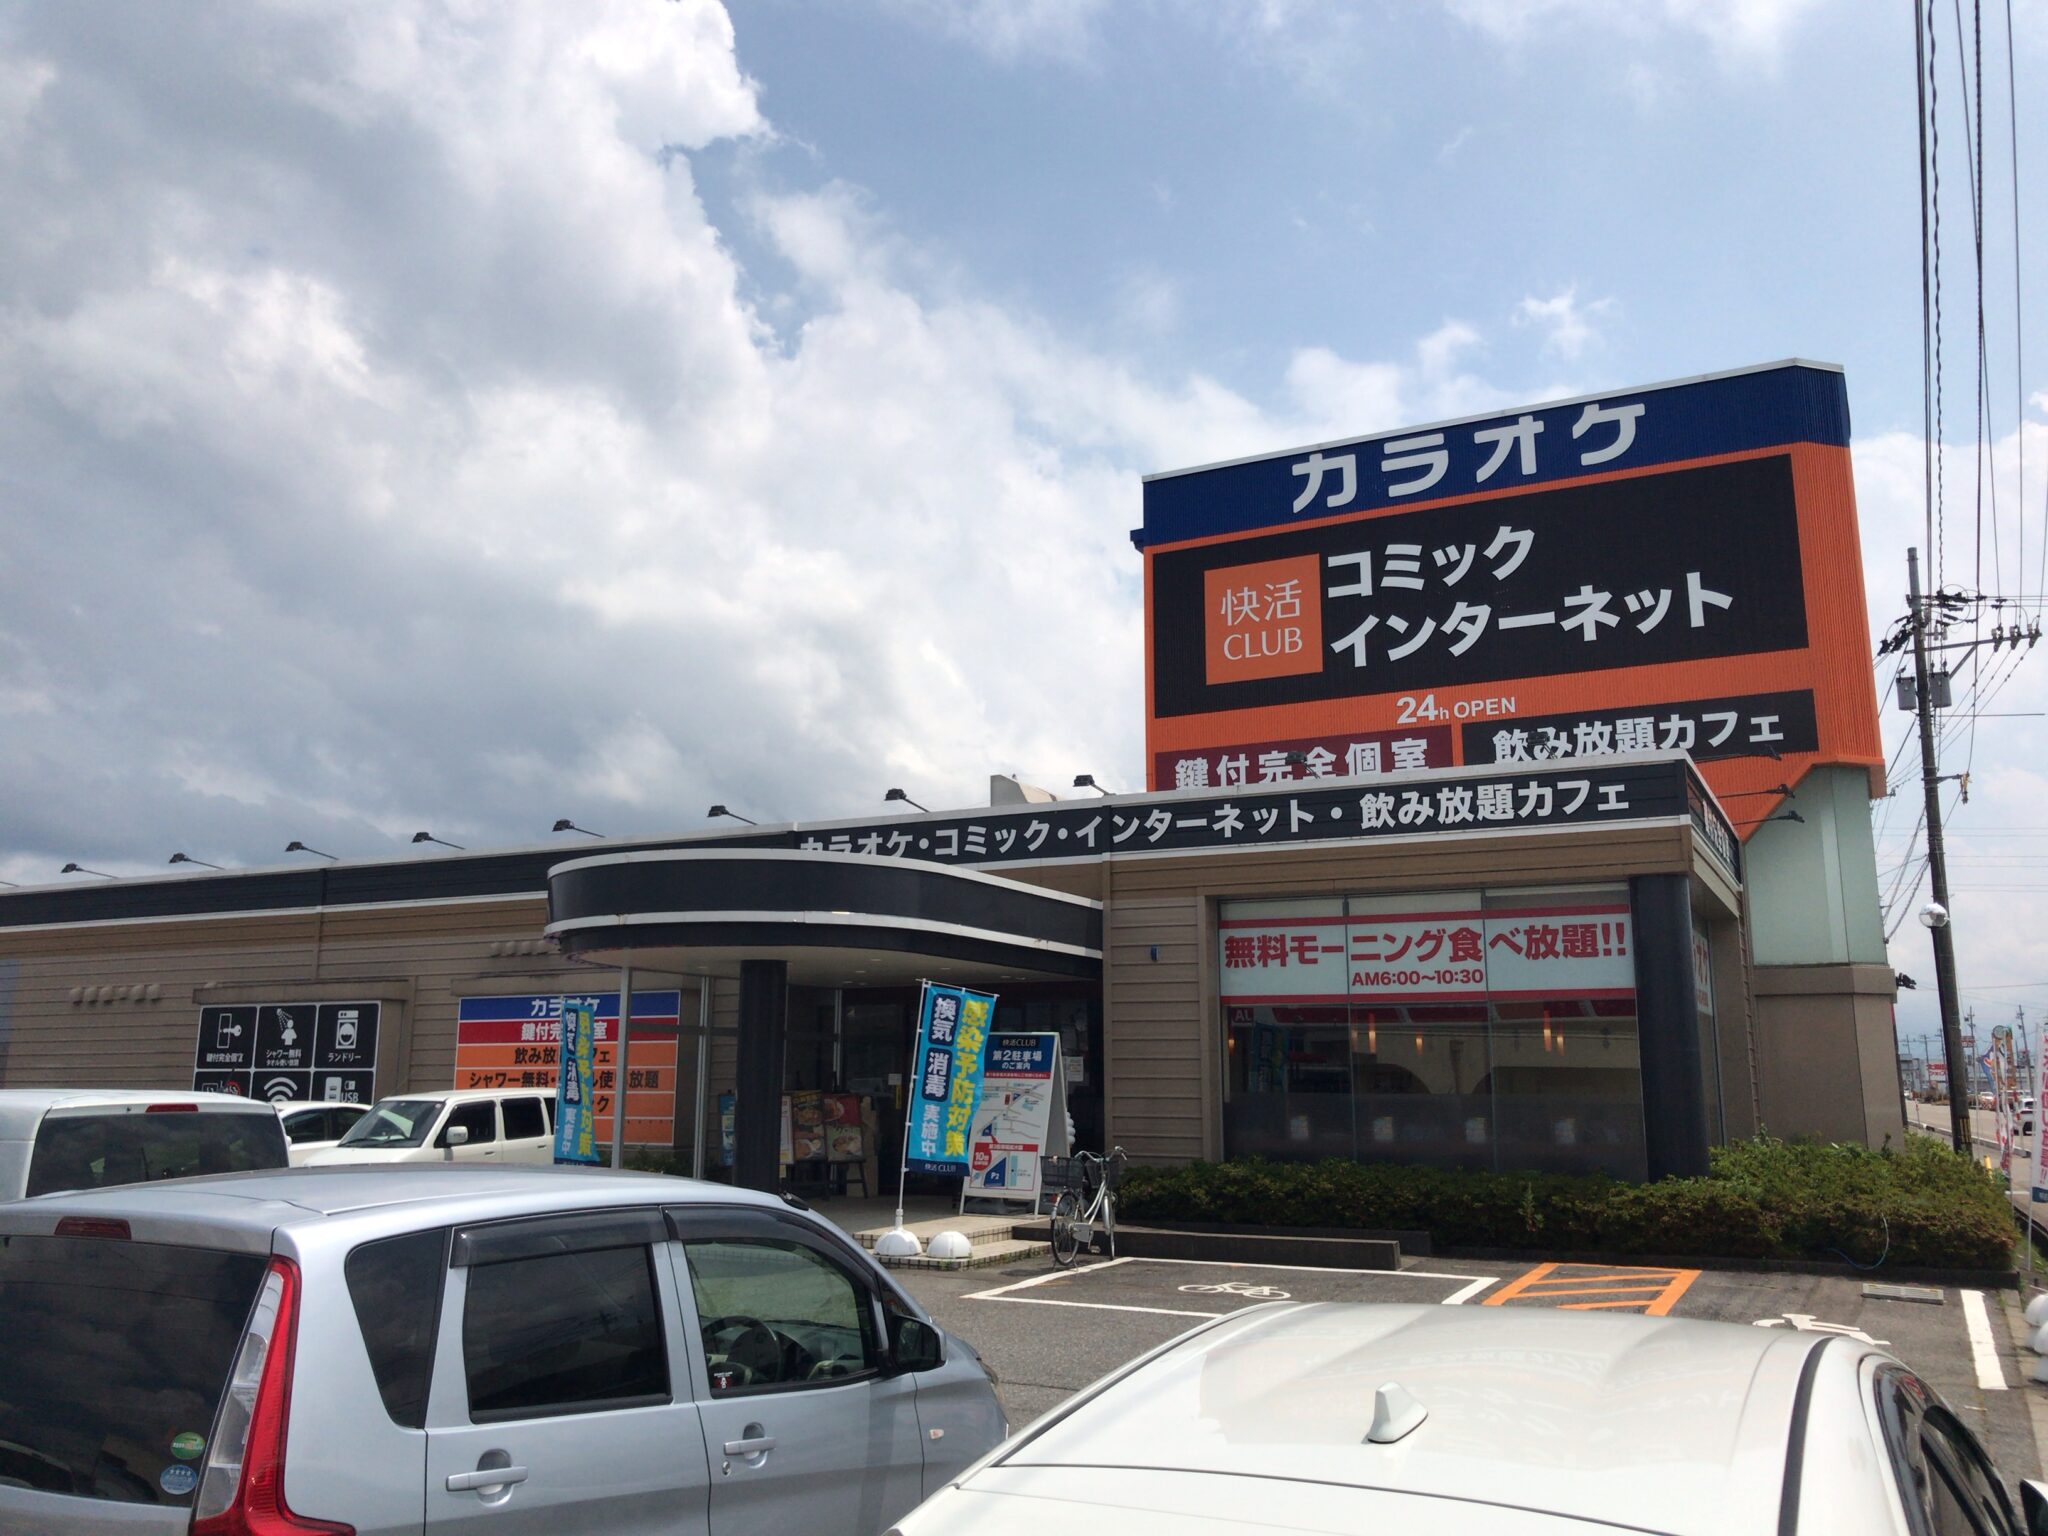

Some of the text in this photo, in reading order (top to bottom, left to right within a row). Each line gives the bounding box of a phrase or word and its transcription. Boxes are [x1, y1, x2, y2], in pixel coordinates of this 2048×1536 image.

[1291, 403, 1645, 514] カラオケ
[1327, 525, 1535, 598] コミック
[1220, 579, 1302, 626] 快活
[1329, 571, 1734, 667] インターネット
[1223, 627, 1303, 660] CLUB
[1396, 694, 1516, 724] 24h OPEN
[328, 1052, 361, 1062] ランドリー
[924, 997, 956, 1098] 換気 消毒
[944, 1000, 989, 1157] 感染予防対策
